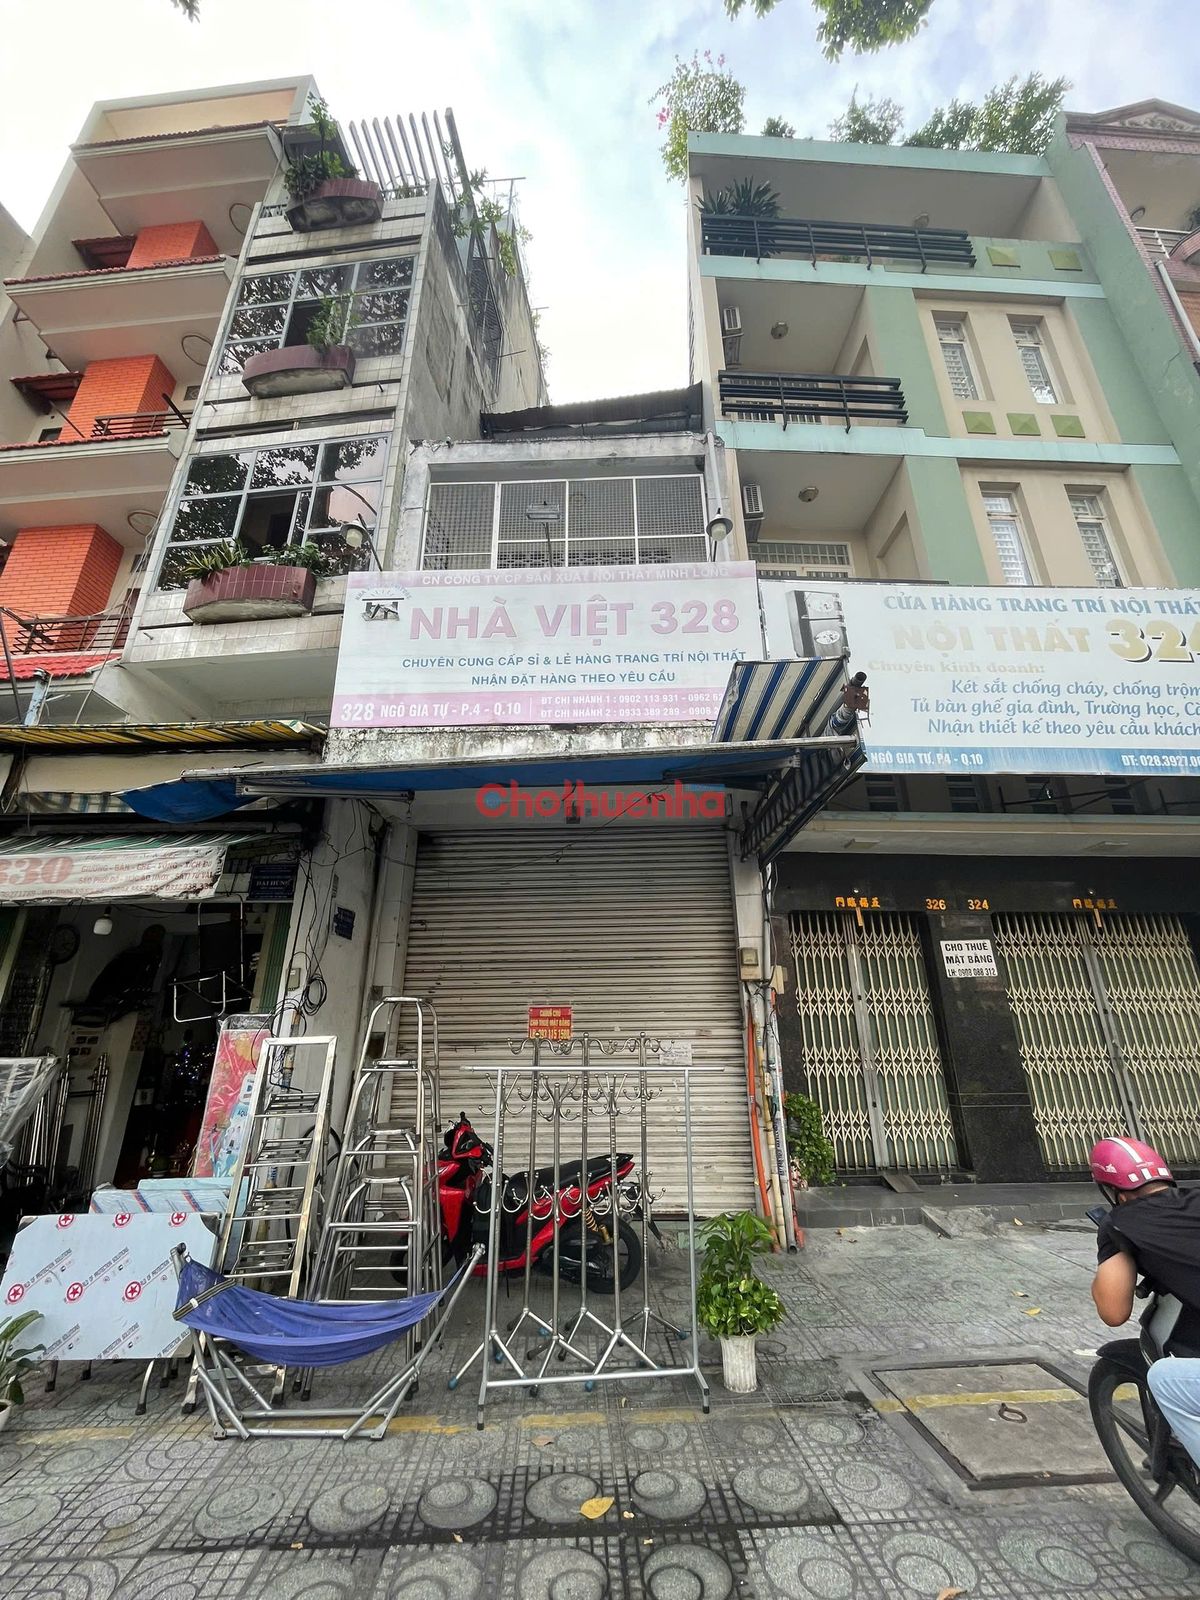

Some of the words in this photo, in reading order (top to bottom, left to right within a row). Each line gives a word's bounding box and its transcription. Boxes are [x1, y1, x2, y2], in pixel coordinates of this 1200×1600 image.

[422, 575, 440, 585] CN
[656, 568, 688, 580] MINH
[884, 591, 927, 610] CỬA
[931, 593, 992, 612] HÀNG
[996, 598, 1067, 613] TRANG
[1072, 596, 1106, 613] TRÍ
[1110, 597, 1151, 616] NỘI
[410, 596, 517, 640] NHÀ
[535, 594, 634, 646] VIỆT
[651, 599, 739, 635] 328
[891, 620, 974, 657] NỘI
[985, 619, 1090, 652] THẤT
[402, 654, 454, 668] CHUYÊN
[458, 656, 494, 667] CUNG
[498, 653, 524, 666] CẤP
[527, 652, 539, 665] SỈ
[543, 656, 551, 665] &
[556, 652, 572, 665] LẺ
[575, 652, 611, 664] HÀNG
[616, 654, 660, 664] TRANG
[664, 651, 684, 663] TRÍ
[688, 651, 709, 664] NỘI
[713, 648, 746, 661] THẤT
[868, 660, 935, 673] Chuyên
[941, 661, 981, 673] kinh
[471, 674, 506, 687] NHẬN
[511, 673, 536, 687] ĐẶT
[541, 672, 577, 684] HÀNG
[580, 673, 616, 683] THEO
[619, 672, 645, 682] YÊU
[649, 669, 676, 682] CẦU
[952, 679, 978, 694] Két
[983, 678, 1007, 694] sắt
[1012, 679, 1061, 697] chống
[1067, 681, 1108, 697] cháy,
[1113, 680, 1161, 698] chống
[554, 695, 570, 704] CHI
[605, 695, 610, 703] 1
[619, 694, 641, 703] 0902
[644, 694, 660, 703] 113
[663, 694, 679, 703] 931
[341, 703, 374, 721] 328
[381, 702, 405, 718] NGÔ
[409, 703, 429, 717] GIA
[433, 702, 449, 719] TỰ
[461, 703, 480, 716] P.4
[494, 702, 521, 716] Q.10
[554, 709, 570, 718] CHI
[619, 708, 641, 717] 0933
[663, 707, 680, 716] 289
[910, 697, 930, 713] Tủ
[935, 698, 967, 713] bàn
[971, 697, 1004, 716] ghế
[1006, 700, 1032, 716] gia
[1038, 700, 1080, 716] đình,
[1084, 700, 1141, 718] Trường
[1147, 702, 1180, 718] học,
[928, 718, 974, 736] Nhận
[979, 717, 1017, 734] thiết
[1022, 717, 1043, 734] kế
[1046, 721, 1081, 735] theo
[1086, 720, 1115, 738] yêu
[1120, 717, 1150, 735] cầu
[870, 750, 893, 764] NGÔ
[896, 753, 916, 764] GIA
[960, 753, 984, 766] Q.10
[1121, 754, 1139, 766] ĐT:
[926, 899, 946, 910] 326
[967, 899, 989, 910] 324
[945, 943, 963, 952] CHO
[965, 941, 988, 951] THUÊ
[945, 954, 965, 966] MẶT
[985, 968, 996, 976] 312
